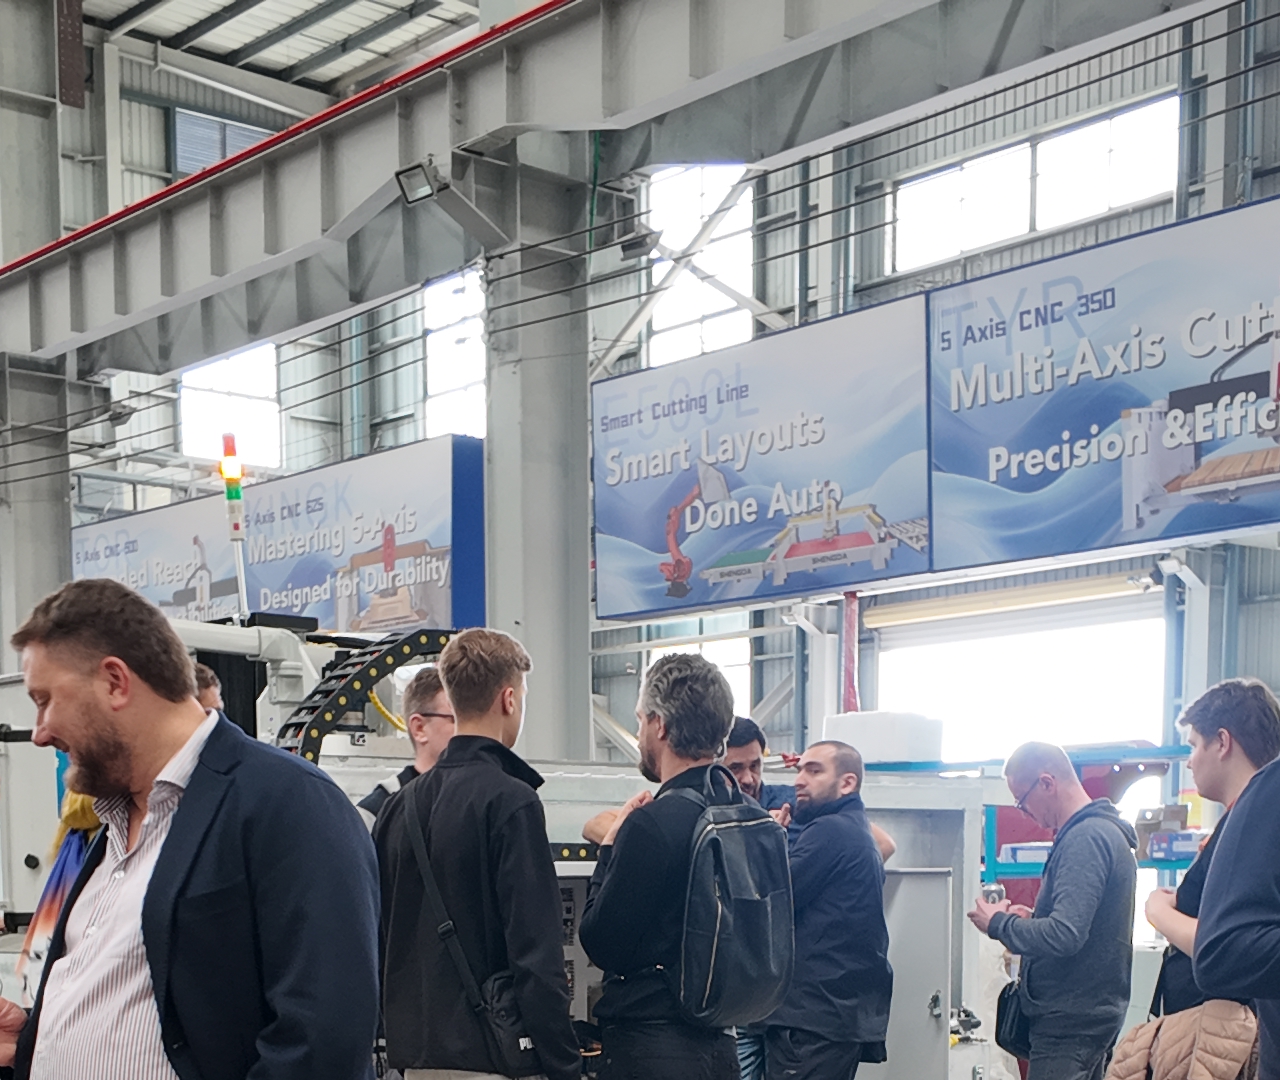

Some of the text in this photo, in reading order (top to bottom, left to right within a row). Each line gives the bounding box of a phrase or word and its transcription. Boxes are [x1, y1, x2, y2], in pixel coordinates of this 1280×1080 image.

[941, 287, 1115, 351] 5 Axis CNC 350
[950, 324, 1166, 413] Multi-Axis
[601, 384, 749, 433] Smart Cutting Line
[605, 411, 825, 487] Smart Layouts
[987, 423, 1150, 484] Precision
[255, 509, 275, 526] Axis
[280, 502, 301, 520] CNC
[685, 479, 843, 534] Done Auto
[248, 523, 345, 566] Mastering
[260, 555, 451, 612] Designed for Durability
